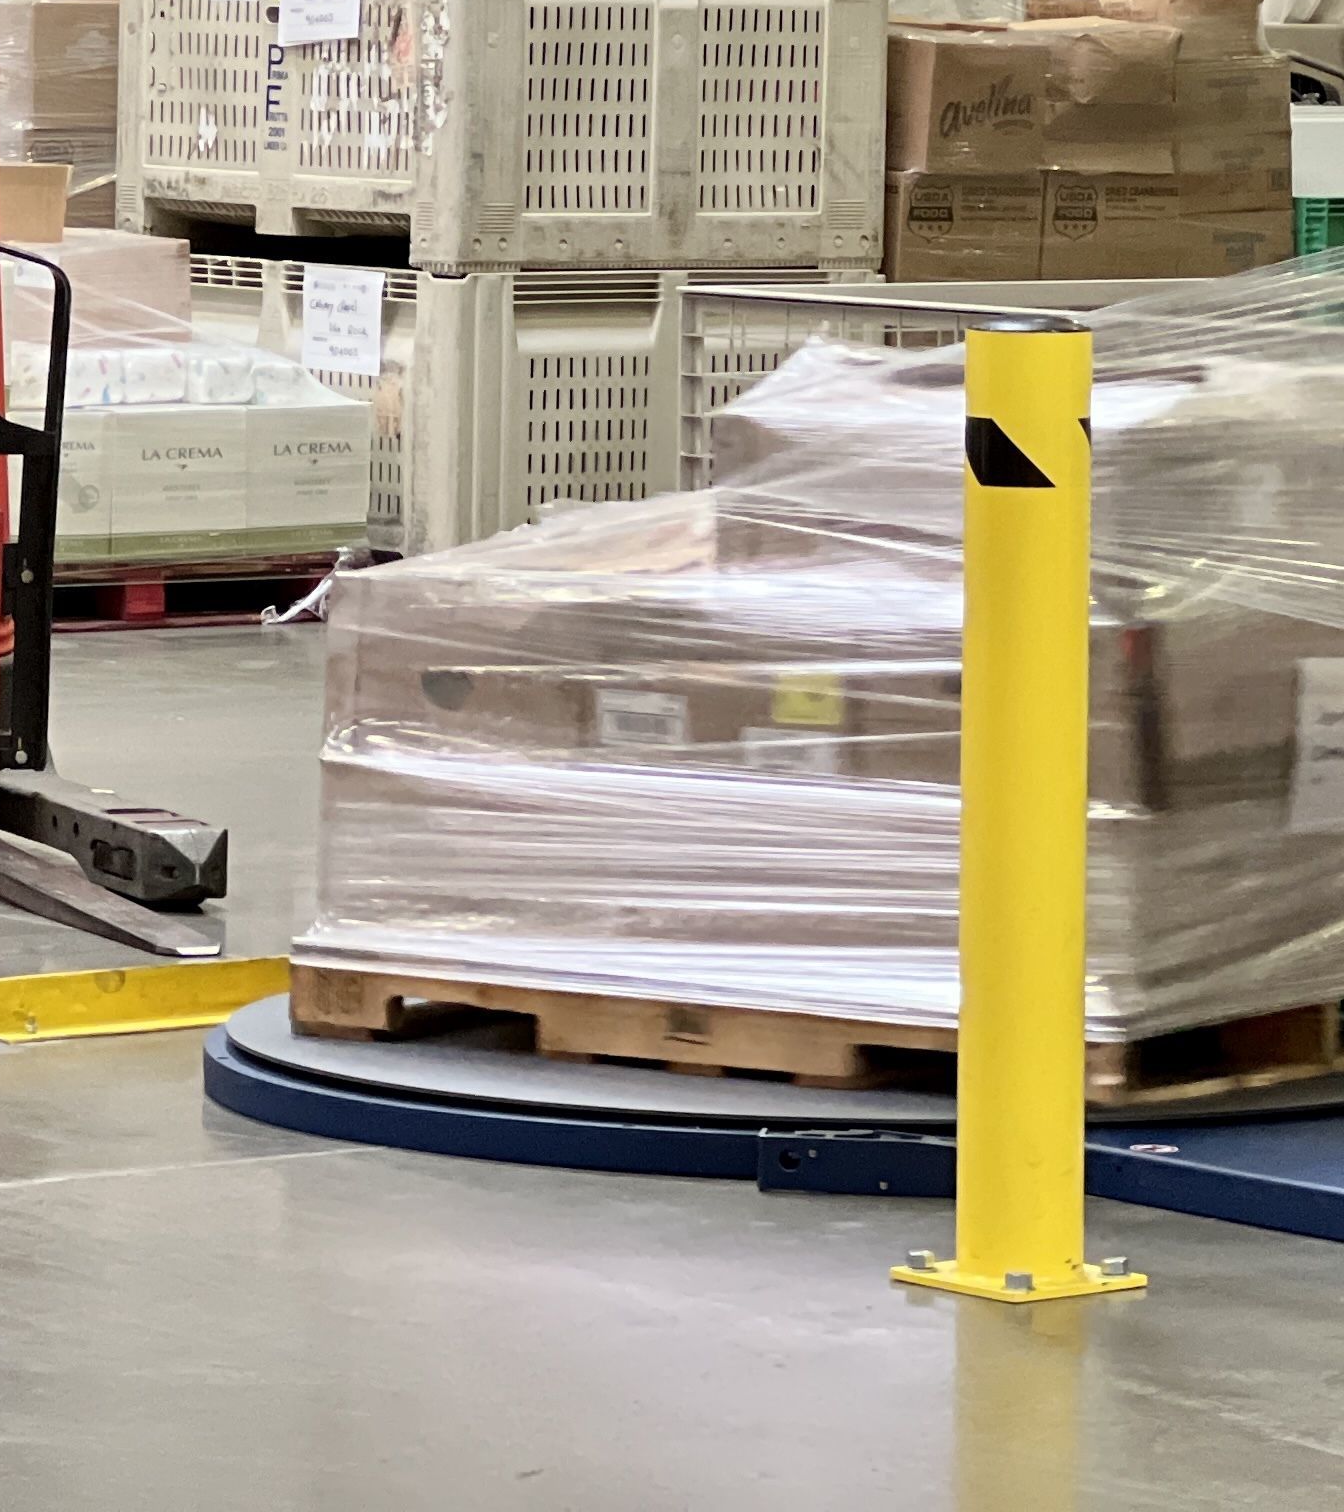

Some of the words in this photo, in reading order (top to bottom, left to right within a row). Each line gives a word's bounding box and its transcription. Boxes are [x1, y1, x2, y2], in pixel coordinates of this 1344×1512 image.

[914, 192, 949, 202] USDA
[1059, 191, 1093, 202] USDA
[62, 441, 95, 451] REMA
[273, 444, 292, 457] LA
[297, 441, 352, 455] CREMA
[142, 449, 161, 462] LA
[166, 447, 223, 461] CREMA
